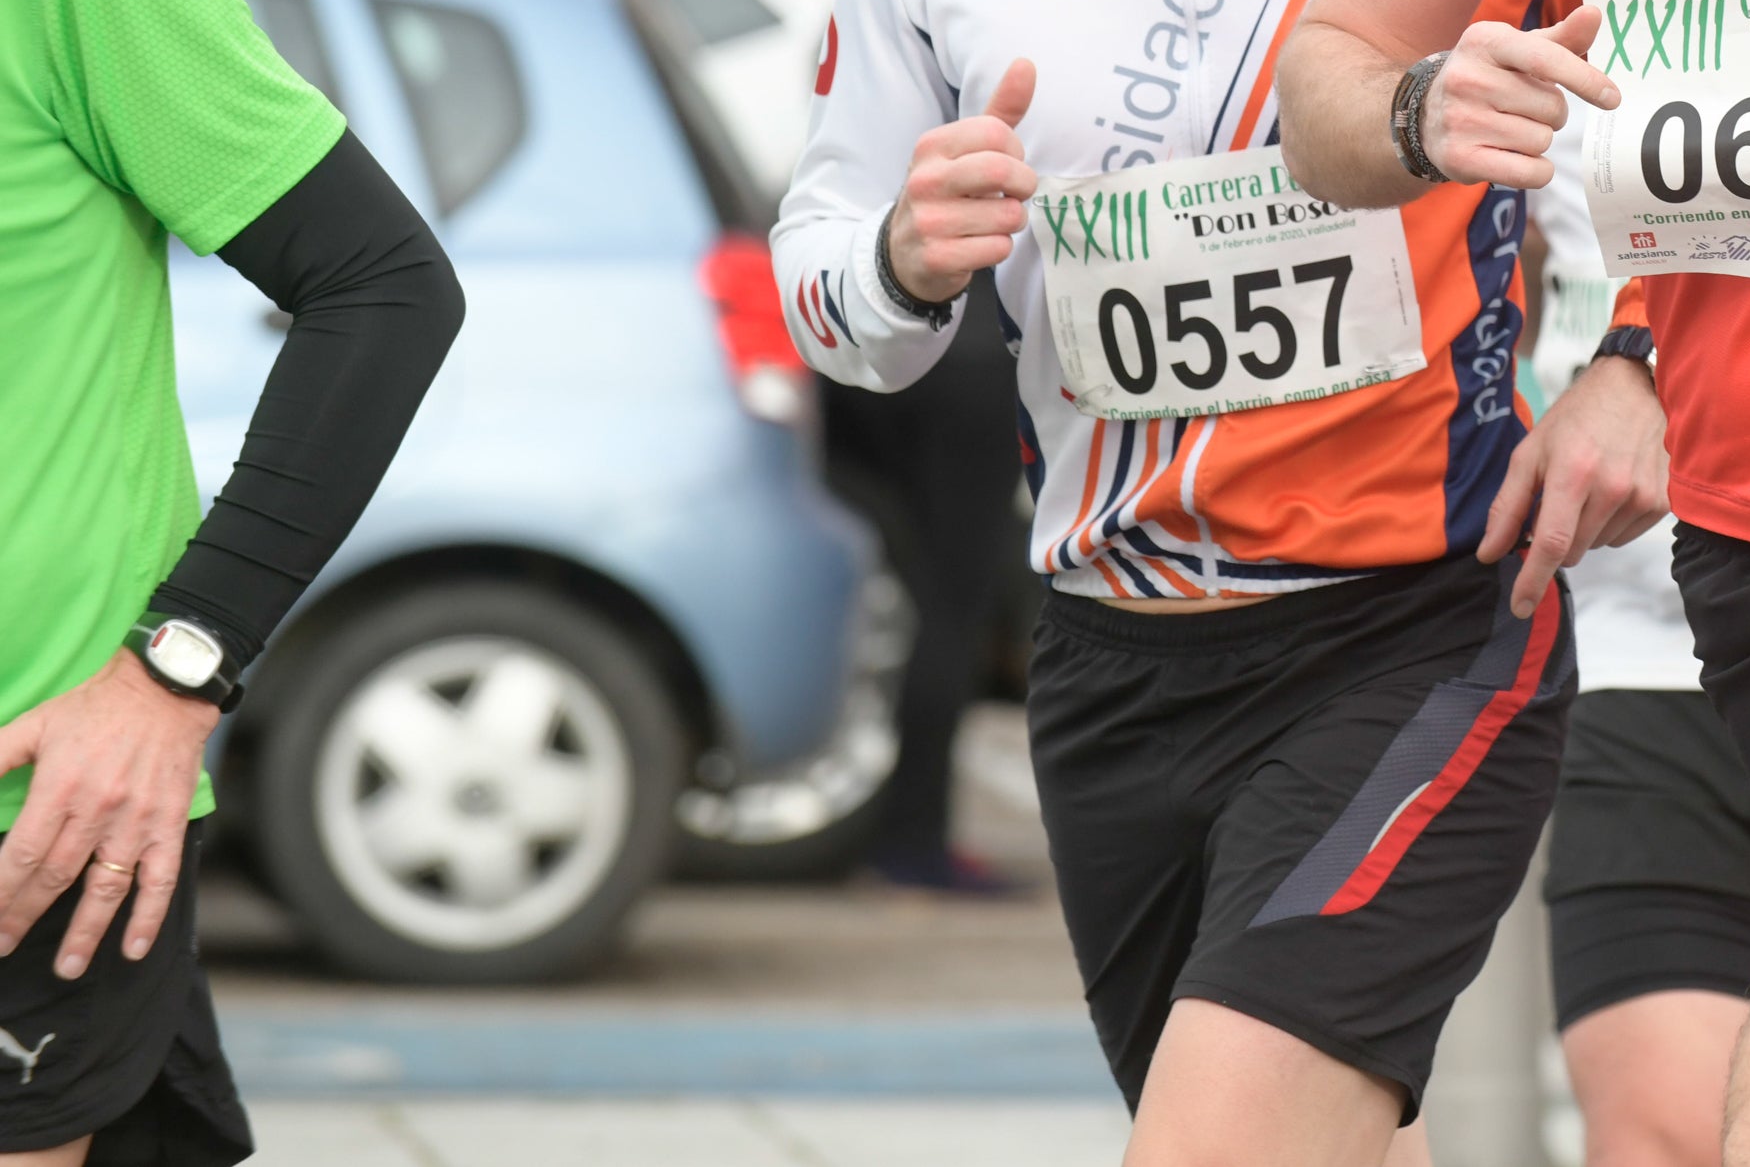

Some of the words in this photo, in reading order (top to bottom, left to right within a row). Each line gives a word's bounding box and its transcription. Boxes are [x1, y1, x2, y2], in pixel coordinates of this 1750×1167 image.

[1162, 174, 1263, 210] Carrera
[1042, 188, 1151, 266] XXIII
[1266, 200, 1352, 227] Bosc
[1731, 208, 1750, 220] en
[1208, 241, 1221, 252] de
[1265, 234, 1278, 245] de
[1617, 248, 1678, 261] salesianos
[1098, 255, 1354, 396] 0557
[1207, 401, 1220, 415] el
[1284, 387, 1327, 404] como
[1332, 381, 1350, 396] en
